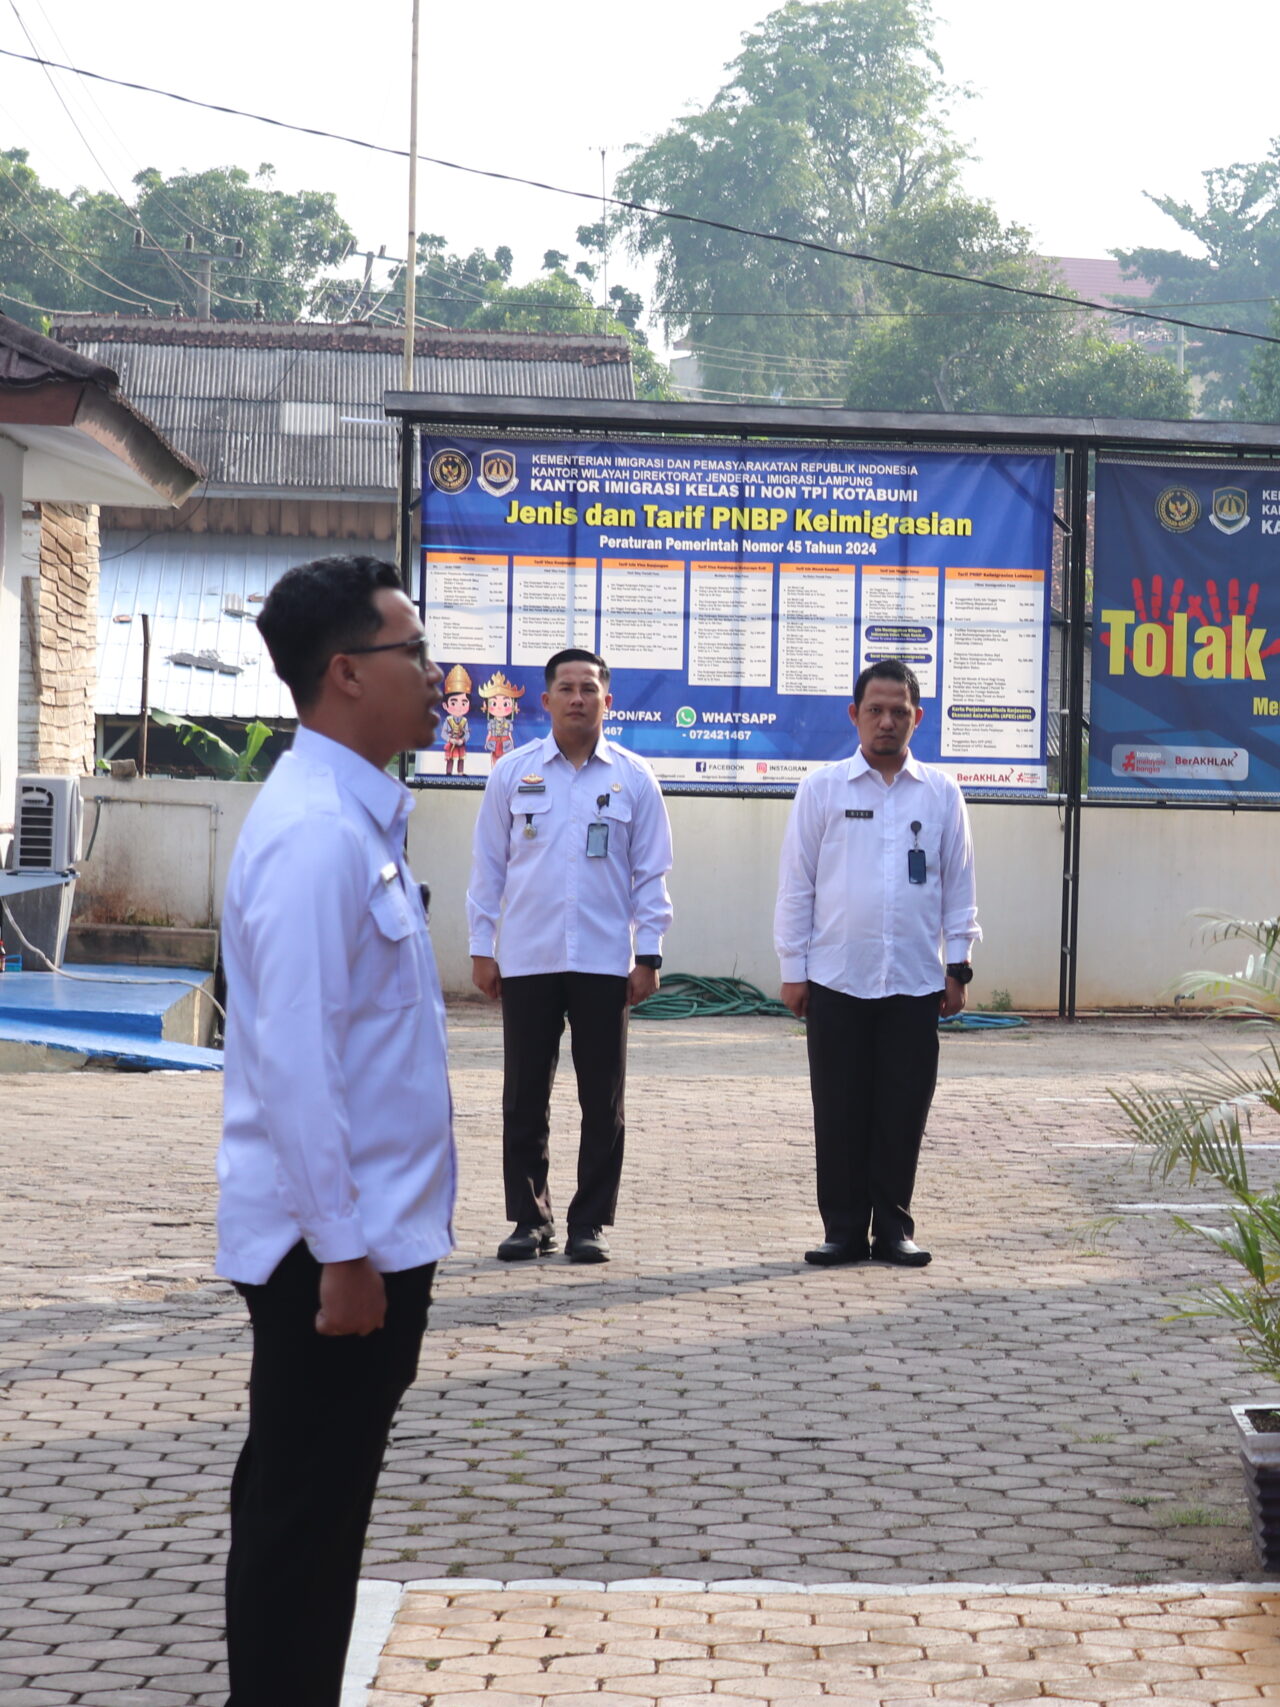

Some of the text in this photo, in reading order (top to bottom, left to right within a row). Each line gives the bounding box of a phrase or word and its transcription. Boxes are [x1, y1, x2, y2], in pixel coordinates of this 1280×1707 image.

[532, 454, 918, 476] KEMENTERIAN IMIGRASI DAN PEMASYARAKATAN REPUBLIK INDONESIA
[532, 467, 873, 487] KANTOR WILAYAH DIREKTORAT JENDERAL IMIGRASI LAMPUNG
[531, 480, 918, 502] KANTOR IMIGRASI KELAS II NON TPI KOTABUMI
[506, 500, 973, 539] Jenis dan Tarif PNBP Keimigrasian
[600, 534, 877, 556] Peraturan Pemerintah Nomor 45 Tahun 2024
[1102, 610, 1268, 680] Tolak
[602, 710, 662, 722] EPON/FAX
[702, 712, 776, 724] WHATSAPP
[689, 730, 752, 741] 072421467
[1175, 756, 1234, 766] BerAKHLAK
[956, 772, 1010, 782] BerAKHLAK
